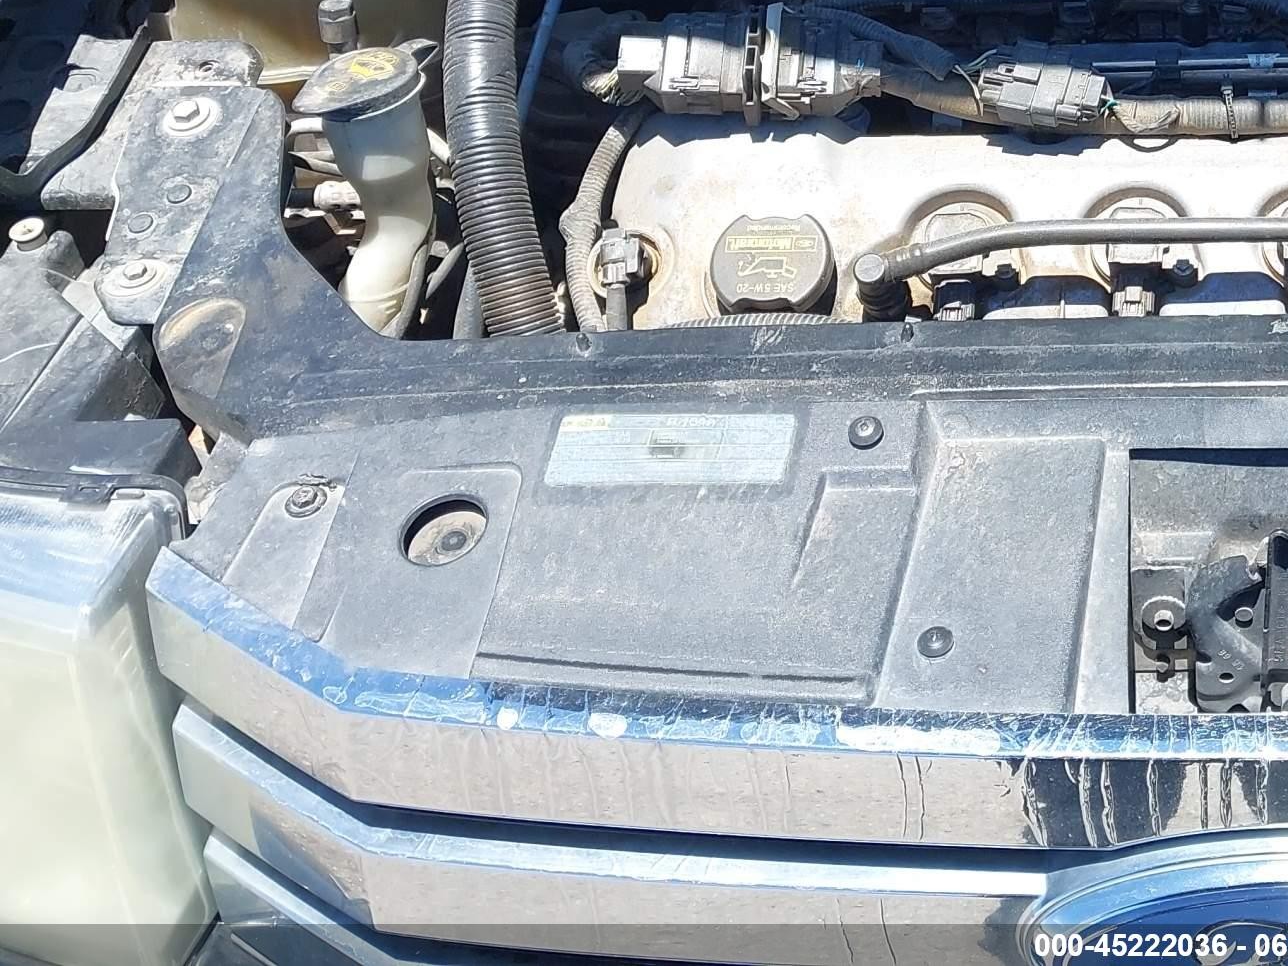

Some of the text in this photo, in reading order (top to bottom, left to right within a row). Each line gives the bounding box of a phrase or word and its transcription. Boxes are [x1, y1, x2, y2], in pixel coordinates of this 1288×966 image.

[728, 237, 793, 251] Motorcraft
[736, 282, 795, 294] SAE 5W-20
